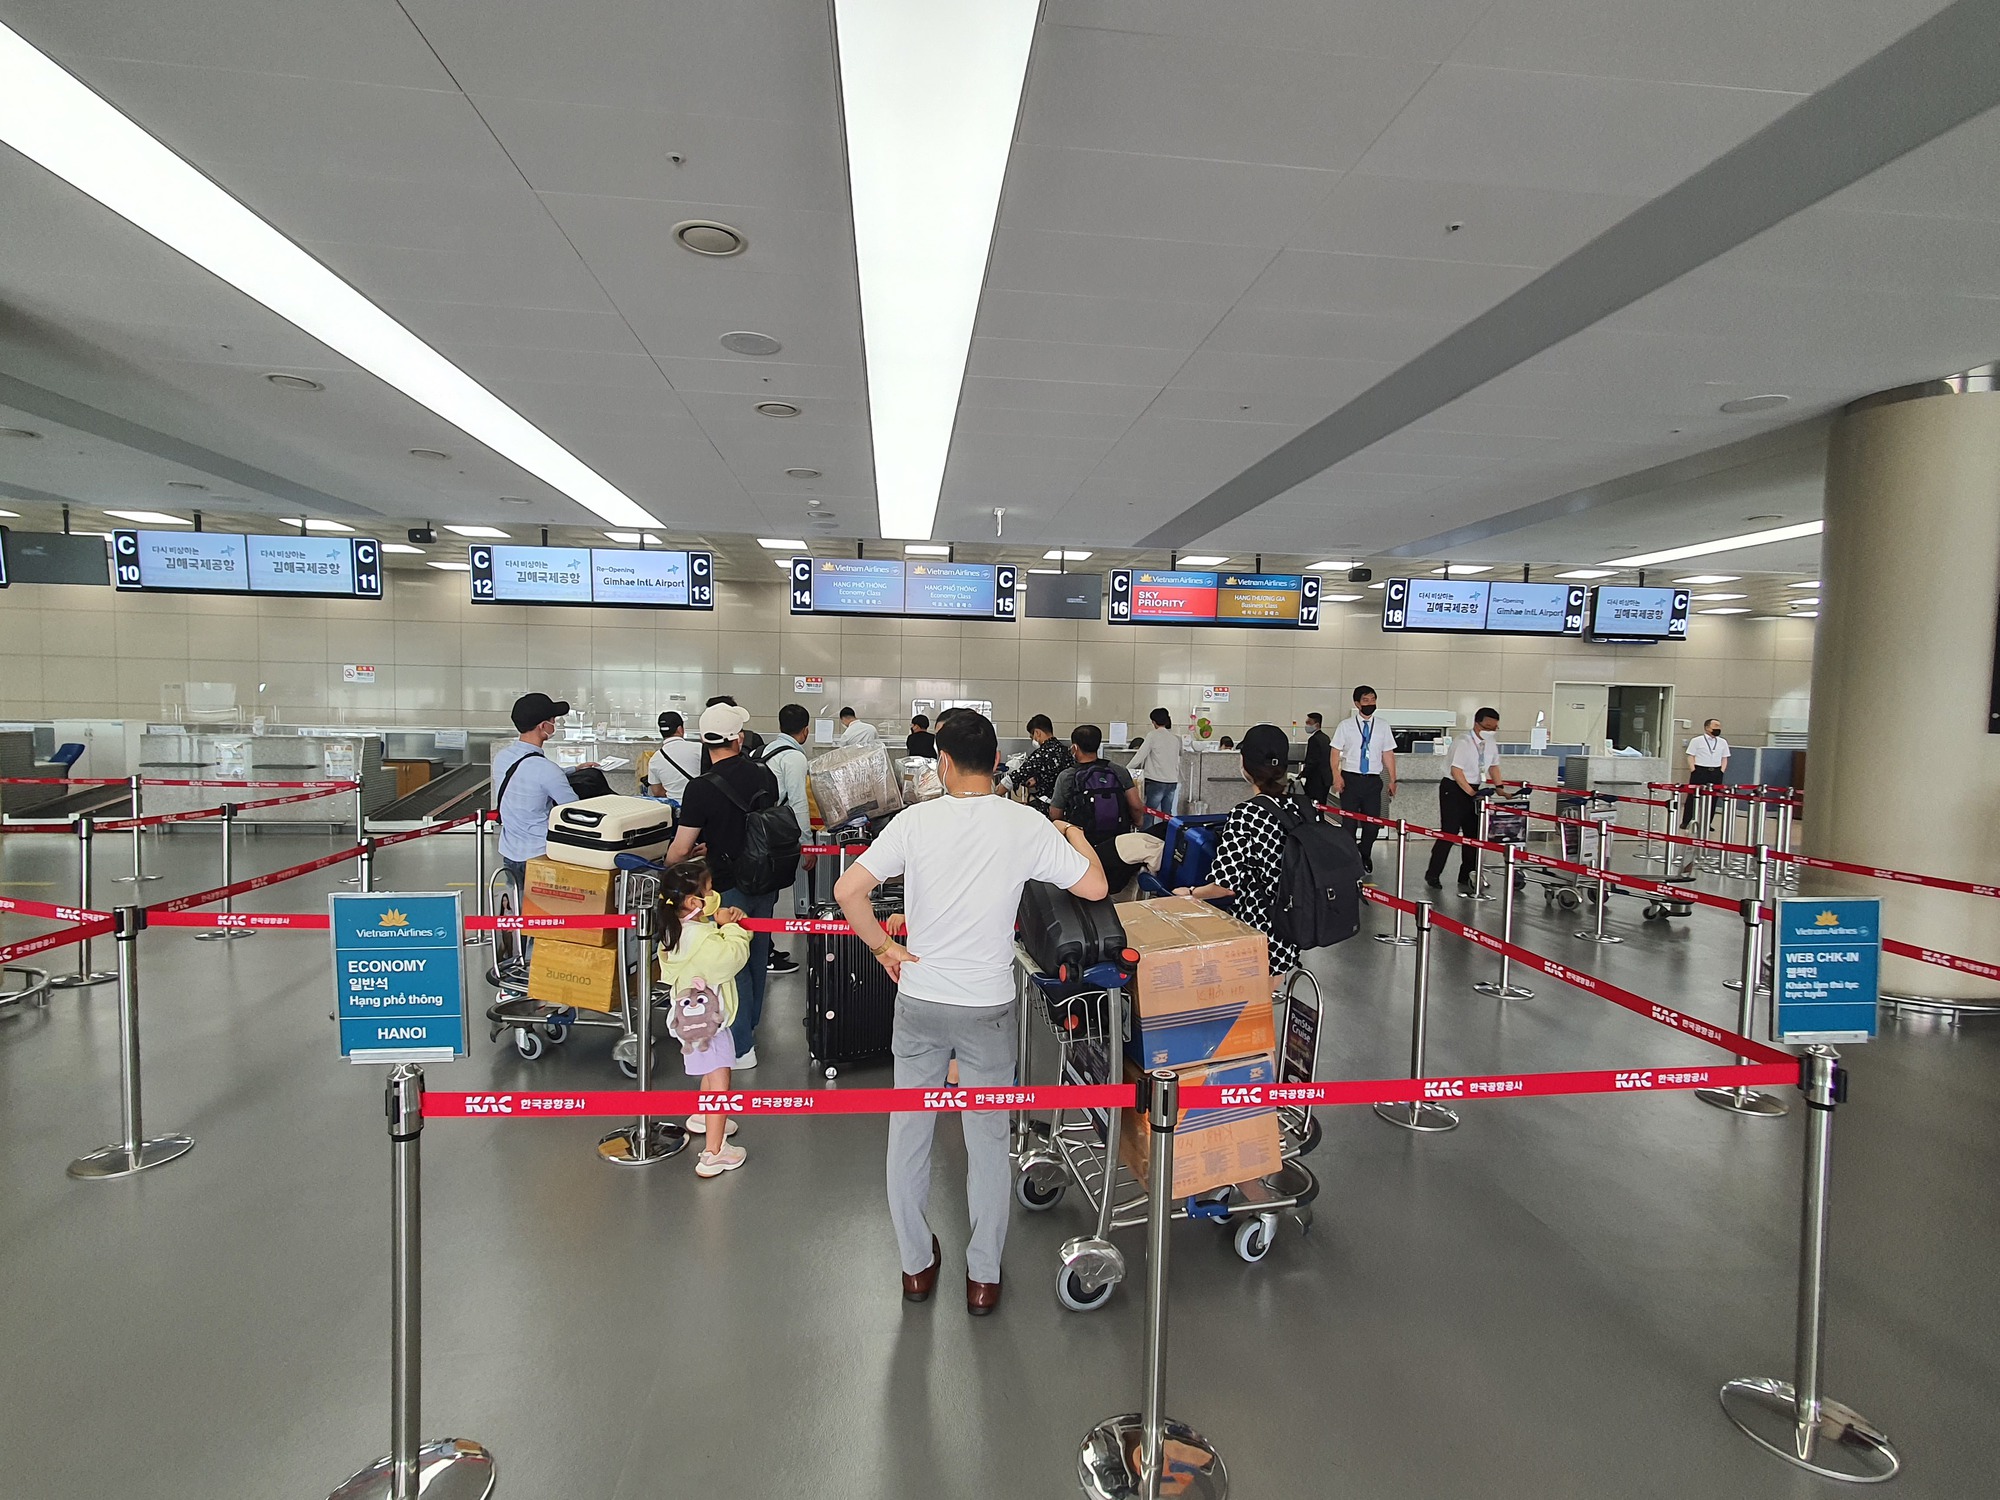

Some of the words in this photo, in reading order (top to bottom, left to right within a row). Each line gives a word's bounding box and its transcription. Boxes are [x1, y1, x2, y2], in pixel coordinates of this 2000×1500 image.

[117, 536, 135, 555] C
[152, 546, 167, 554] 다시
[169, 546, 199, 555] 비상하는
[261, 550, 275, 558] 다시
[358, 545, 374, 564] C
[473, 551, 489, 569] C
[165, 558, 235, 571] 김해국제공항
[272, 561, 340, 575] 김해국제공항
[505, 560, 519, 568] 다시
[521, 560, 548, 569] 비상하는
[597, 566, 635, 574] Re-Opening
[693, 558, 708, 576] C
[118, 565, 140, 582] 10
[517, 571, 580, 584] 김해국제공항
[795, 564, 809, 580] C
[359, 573, 376, 589] 11
[473, 579, 493, 594] 12
[603, 577, 635, 586] Gimhae
[655, 579, 685, 588] Airport
[999, 571, 1013, 588] C
[1114, 576, 1128, 592] C
[692, 586, 710, 600] 13
[930, 592, 956, 600] Economy
[1138, 591, 1159, 599] SKY
[1304, 582, 1318, 597] C
[1390, 584, 1404, 600] C
[793, 591, 811, 605] 14
[996, 598, 1014, 612] 15
[1138, 599, 1185, 608] PRIORITY
[1569, 591, 1583, 606] C
[1674, 594, 1687, 609] C
[1112, 601, 1128, 615] 16
[1301, 607, 1318, 620] 17
[1427, 602, 1479, 613] 김해국제공항
[1497, 608, 1523, 616] Gimhae
[1538, 609, 1563, 617] Airport
[1387, 609, 1403, 623] 18
[1566, 615, 1580, 628] 19
[1669, 619, 1686, 631] 20
[217, 915, 246, 926] KAC
[497, 917, 524, 928] KAC
[785, 921, 811, 931] KAC
[1785, 953, 1815, 963] WEB
[1816, 952, 1860, 963] CHK-IN
[348, 959, 427, 973] ECONOMY
[349, 977, 389, 991] 일반석
[546, 968, 592, 986] coupang
[350, 995, 381, 1008] Hạng
[383, 992, 406, 1007] phổ
[408, 994, 443, 1007] thông
[1291, 1012, 1314, 1033] PanStar
[1652, 1005, 1678, 1026] KAC
[377, 1027, 427, 1040] HANOI
[1292, 1024, 1311, 1042] Cruise
[1615, 1072, 1652, 1089] KAC
[1658, 1073, 1709, 1084] 한국공항공사
[1221, 1087, 1262, 1104] KAC
[1269, 1088, 1325, 1100] 한국공항공사
[1424, 1080, 1464, 1098] KAC
[1470, 1081, 1523, 1093] 한국공항공사
[465, 1096, 512, 1113] KAC
[521, 1098, 586, 1110] 한국공항공사
[698, 1094, 743, 1111] KAC
[751, 1097, 814, 1108] 한국공항공사
[924, 1091, 967, 1108] KAC
[975, 1093, 1035, 1105] 한국공항공사
